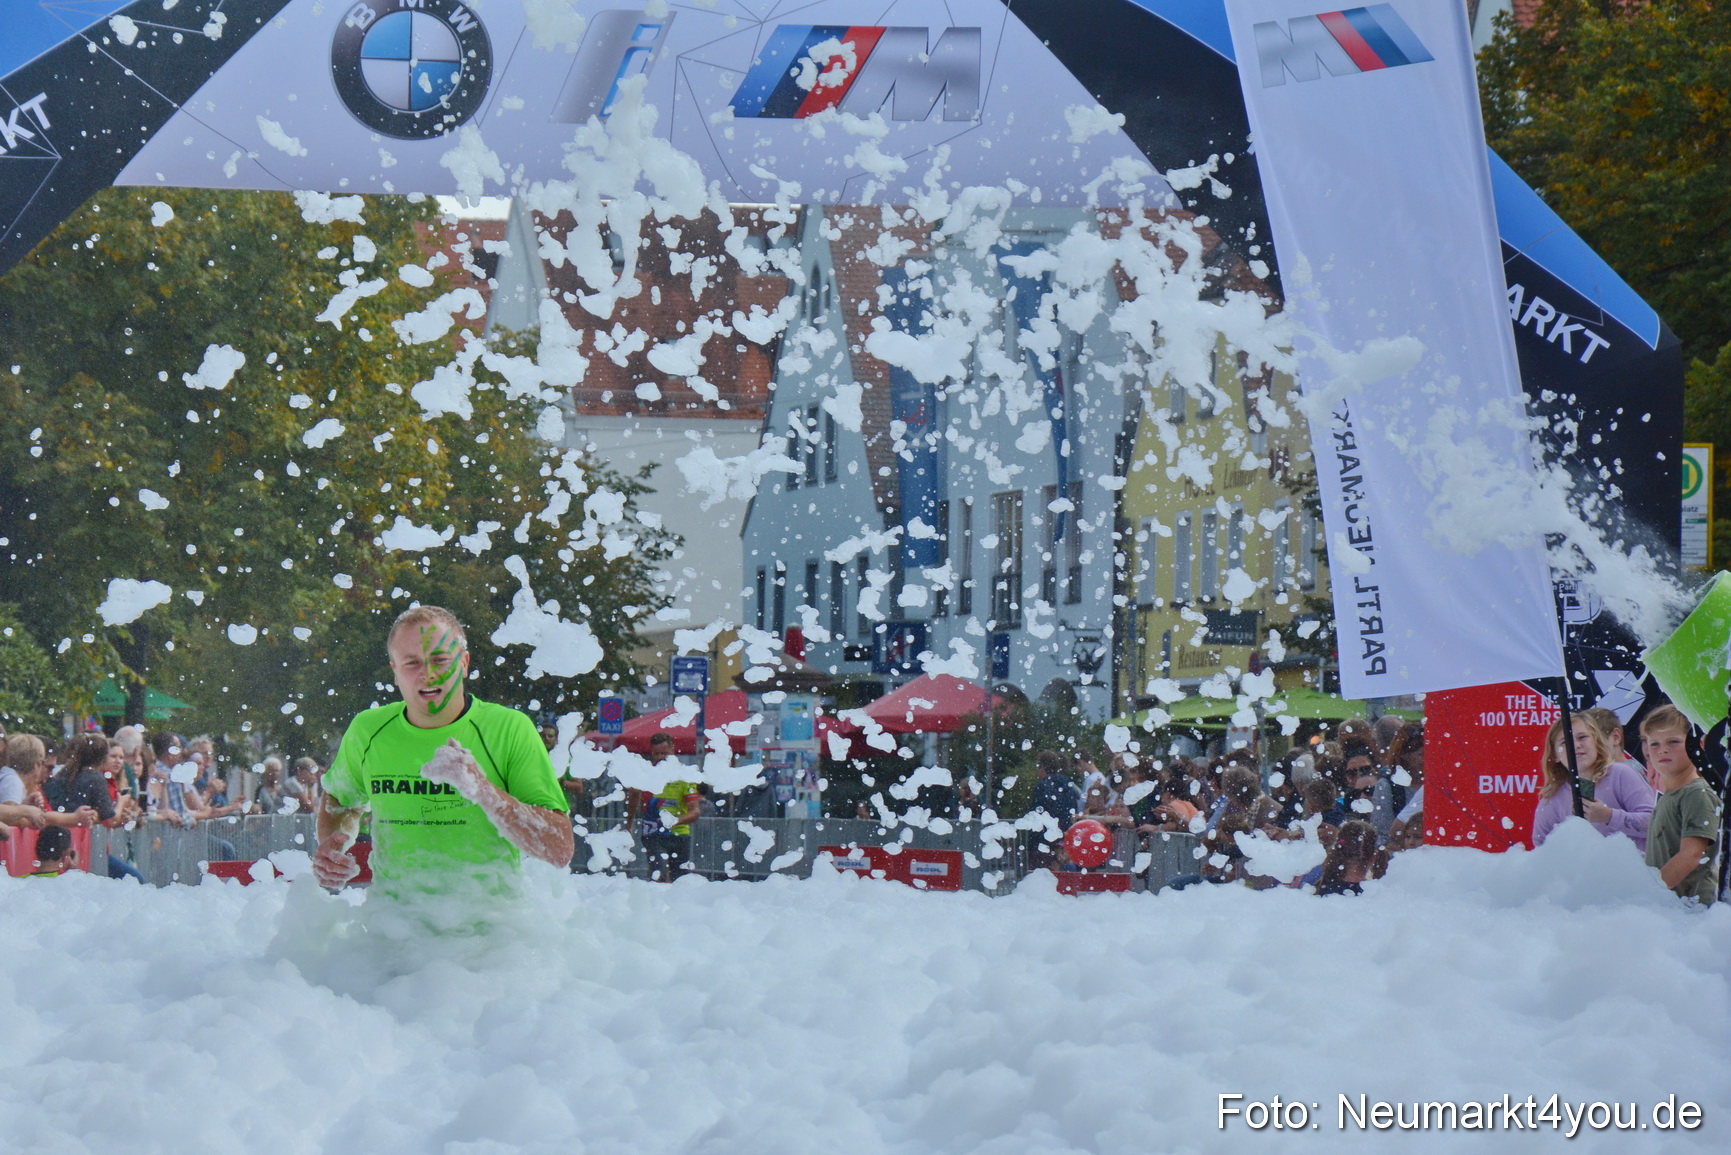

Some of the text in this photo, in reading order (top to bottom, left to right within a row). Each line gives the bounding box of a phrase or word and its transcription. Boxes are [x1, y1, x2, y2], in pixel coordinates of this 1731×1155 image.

[0, 91, 51, 155] KT
[1505, 694, 1537, 710] THE
[601, 722, 621, 732] TAXI
[1480, 711, 1562, 727] 100 YEARS
[371, 779, 455, 795] BRANDL
[1478, 774, 1539, 794] BMW
